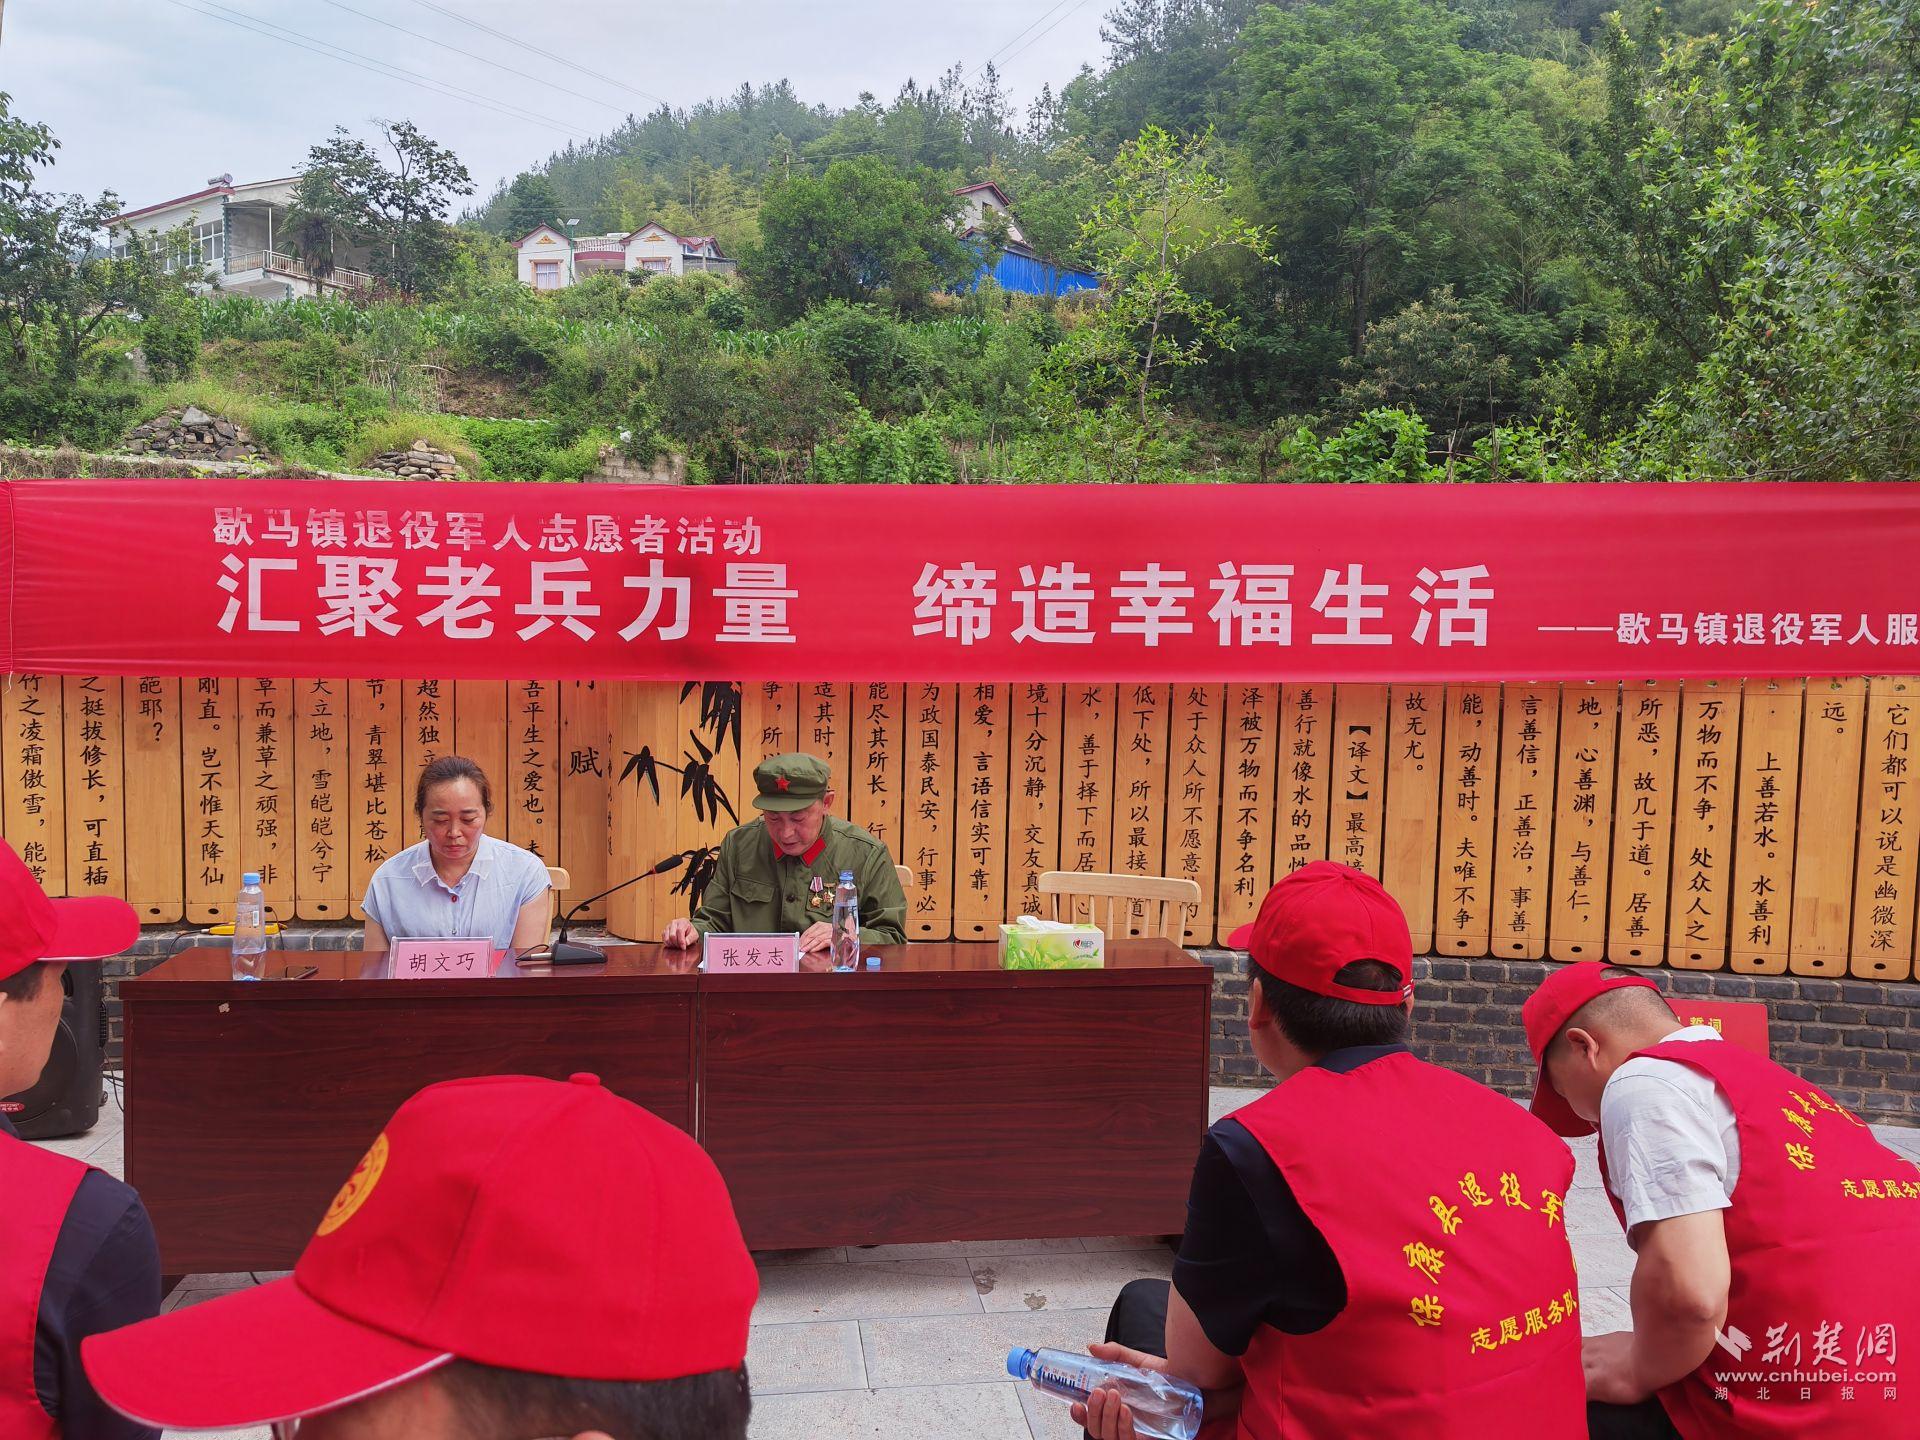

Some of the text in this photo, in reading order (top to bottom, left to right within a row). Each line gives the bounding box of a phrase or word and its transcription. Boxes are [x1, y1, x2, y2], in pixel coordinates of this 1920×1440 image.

[212, 506, 764, 555] 歇马镇退役军人志愿者活动
[215, 554, 1495, 649] 汇聚老兵力量 缔造幸福生活
[761, 682, 785, 760] 争，所
[915, 683, 943, 914] 为政国泰民安，行事必
[969, 684, 996, 904] 相爱，言语信实可靠，
[1019, 684, 1049, 916] 境十分沉静，交友真诚
[1233, 687, 1265, 912] 泽被万物而不争名利，
[1403, 691, 1429, 774] 故无尤。
[1452, 693, 1485, 930] 能，动善时。夫唯不争
[1507, 695, 1543, 932] 言善信，正善治，事善
[1566, 697, 1603, 924] 地，心善渊，与善仁，
[1624, 698, 1665, 939] 所恶，故几于道。居善
[1685, 700, 1725, 942] 万物而不争，处众人之
[1820, 701, 1849, 735] 远。
[1869, 703, 1911, 951] 它们都可以说是幽微深
[721, 947, 785, 969] 张发志
[1747, 750, 1783, 946] 上善若水。水善利
[408, 951, 475, 975] 胡文巧
[1470, 1288, 1578, 1354] 志愿服务队
